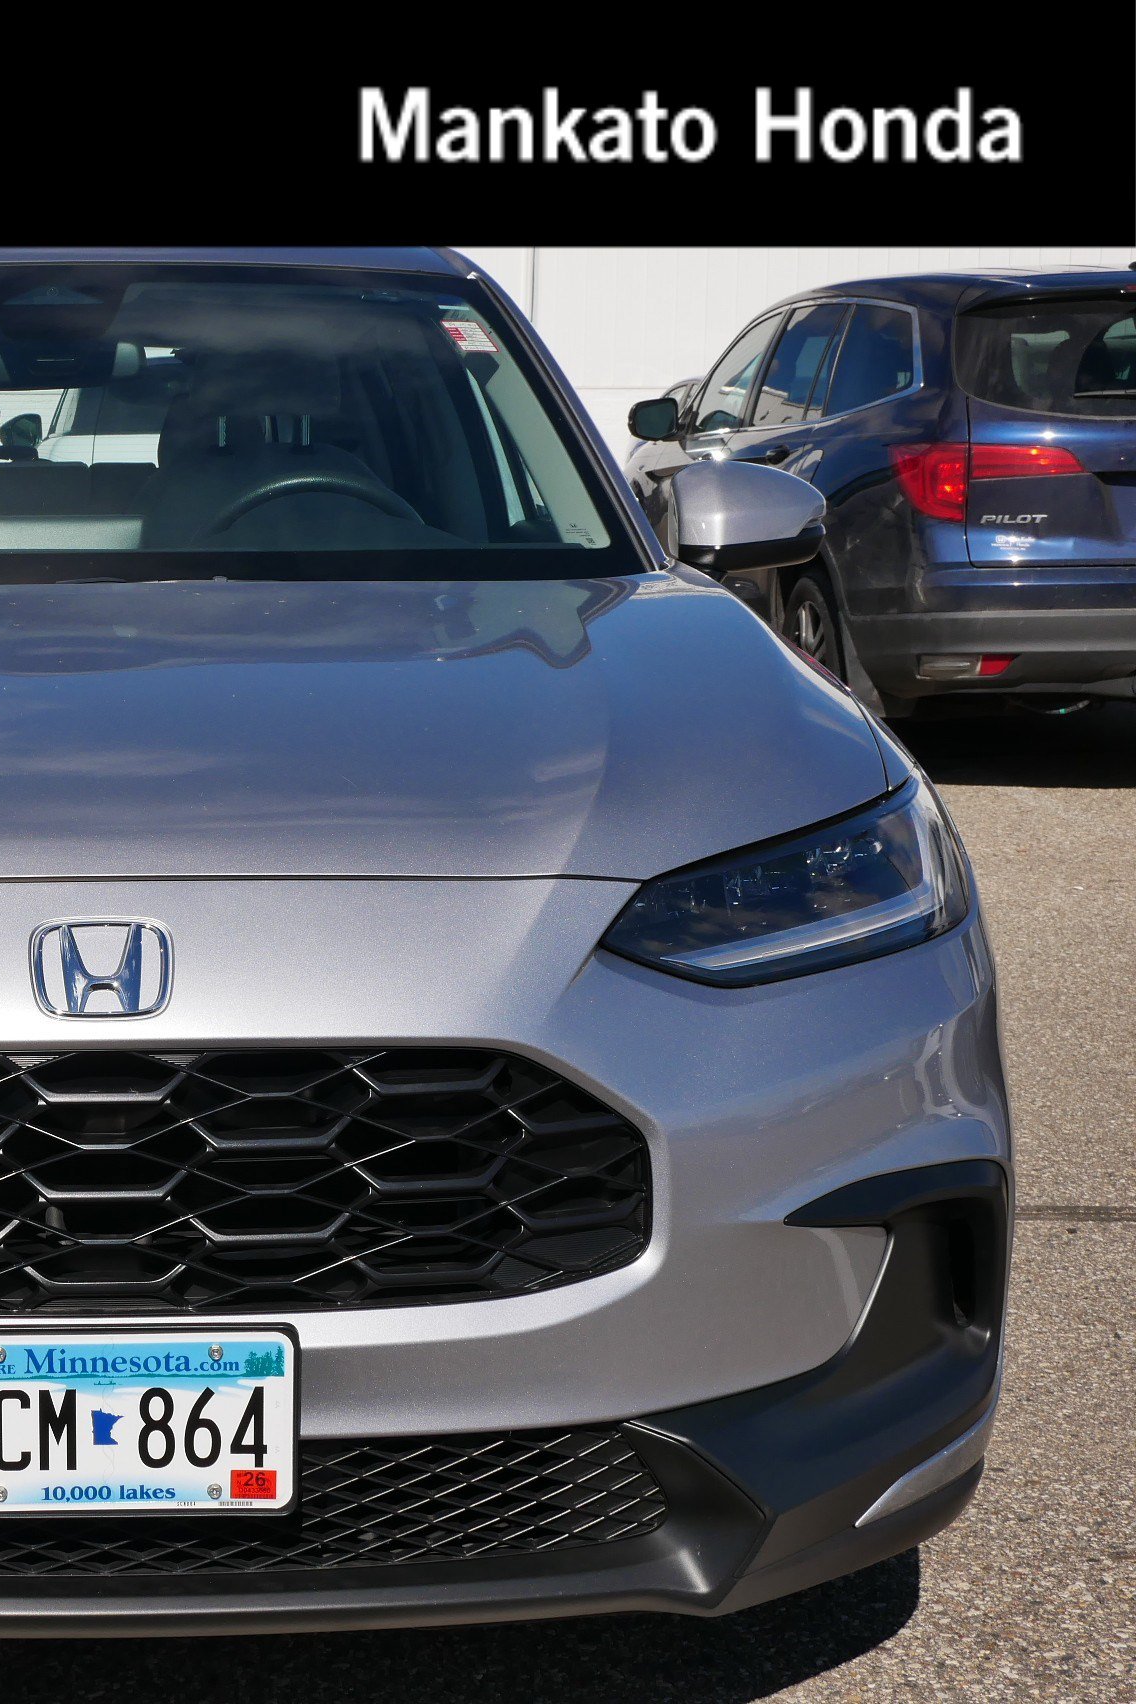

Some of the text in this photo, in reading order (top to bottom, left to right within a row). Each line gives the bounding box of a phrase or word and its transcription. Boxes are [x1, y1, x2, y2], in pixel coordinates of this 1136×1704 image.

[980, 514, 1048, 524] PILOT
[24, 1347, 240, 1375] Minnesota.com
[138, 1386, 268, 1470] 864
[243, 1471, 266, 1487] 26
[41, 1484, 176, 1503] 10,000 lakes
